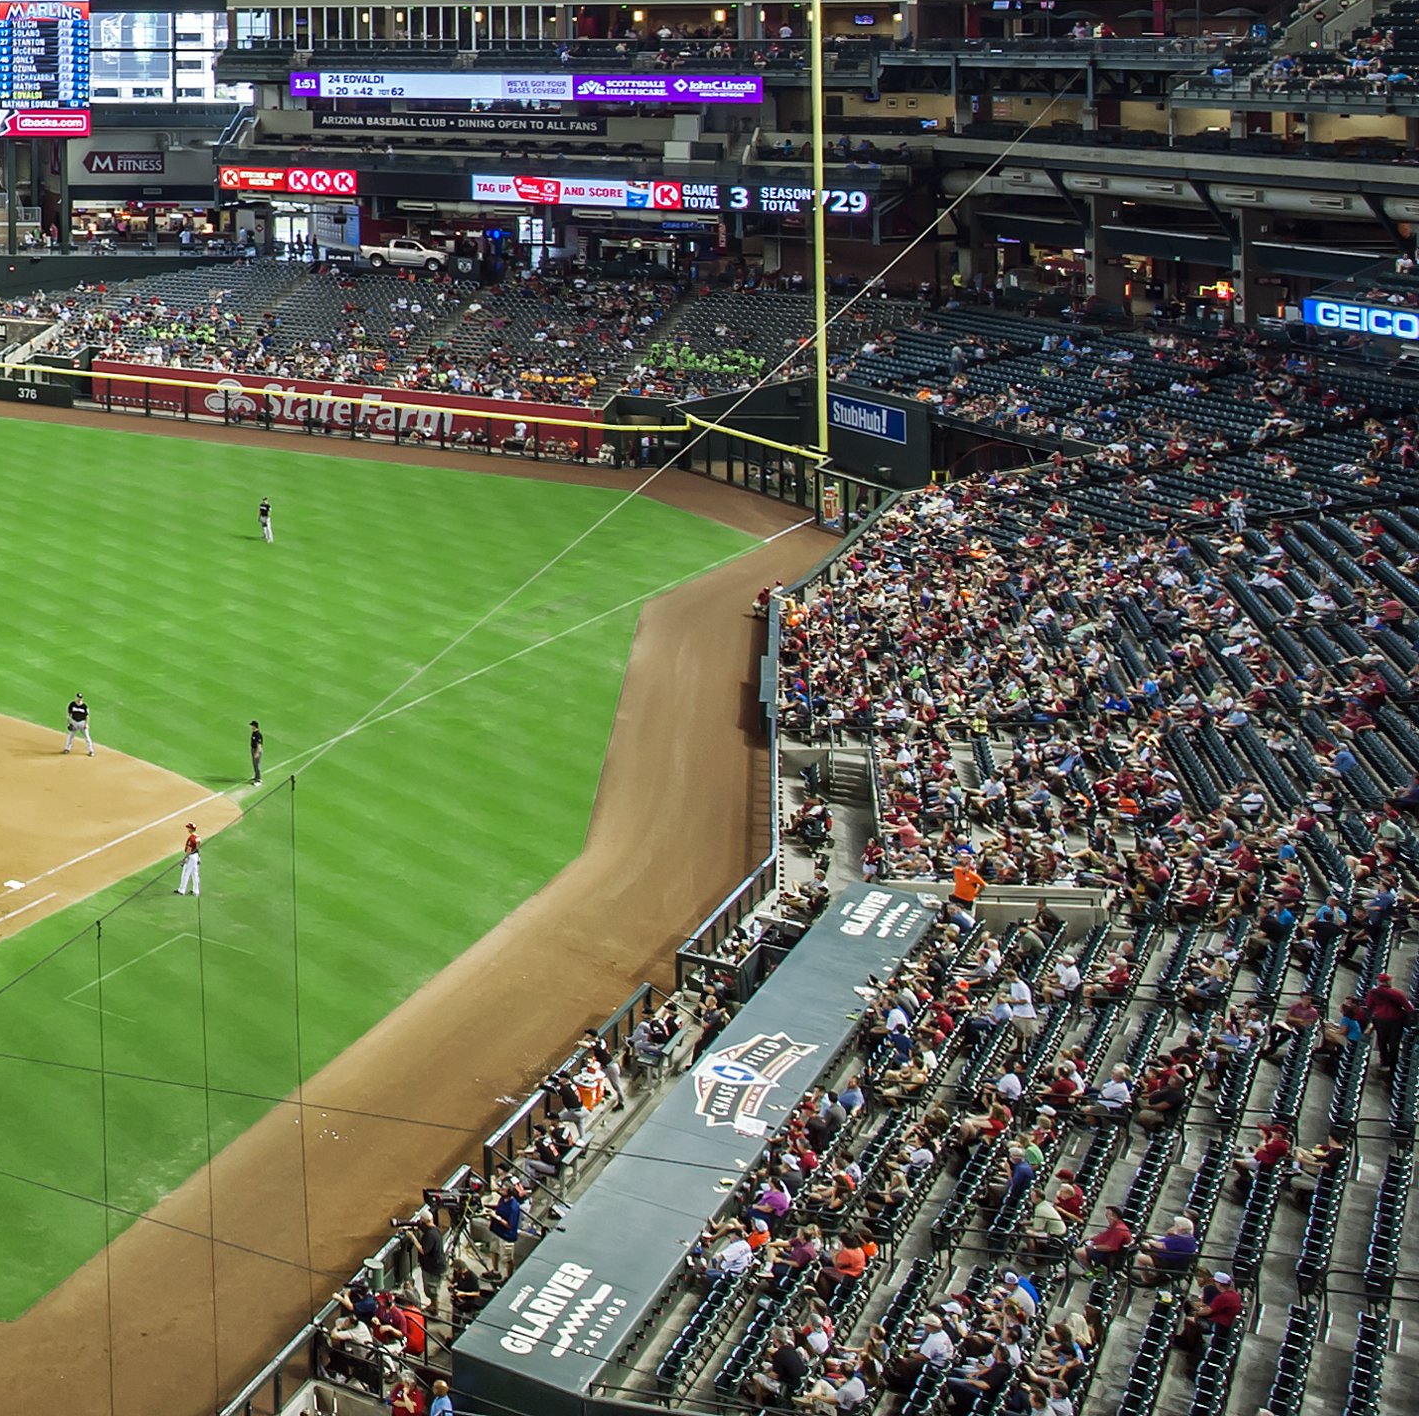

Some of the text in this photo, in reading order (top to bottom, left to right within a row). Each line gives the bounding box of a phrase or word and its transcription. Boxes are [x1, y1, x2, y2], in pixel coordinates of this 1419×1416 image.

[6, 3, 81, 20] MARLINS
[294, 79, 316, 89] 1:51
[328, 75, 384, 84] 24 EOVALDI
[689, 81, 757, 91] John Lincoln
[21, 118, 82, 128] dbacks.com
[321, 116, 597, 131] ARIZONA BASEBALL CLUB DINING OPEN TO ALL FANS
[117, 160, 162, 171] FITNESS
[477, 182, 495, 193] TAG
[497, 183, 511, 194] UP
[564, 186, 585, 196] AND
[589, 187, 623, 198] SCORE
[682, 184, 718, 196] GAME
[761, 187, 811, 200] SEASON
[682, 196, 720, 209] TOTAL
[729, 187, 749, 209] 3
[761, 200, 800, 212] TOTAL
[1316, 302, 1419, 339] GEICO
[18, 387, 37, 400] 376
[261, 383, 453, 435] State Farm
[833, 401, 887, 434] StubHub!
[743, 1041, 781, 1066] FIELD
[711, 1084, 739, 1116] CHASE
[575, 1298, 627, 1355] CASINOS
